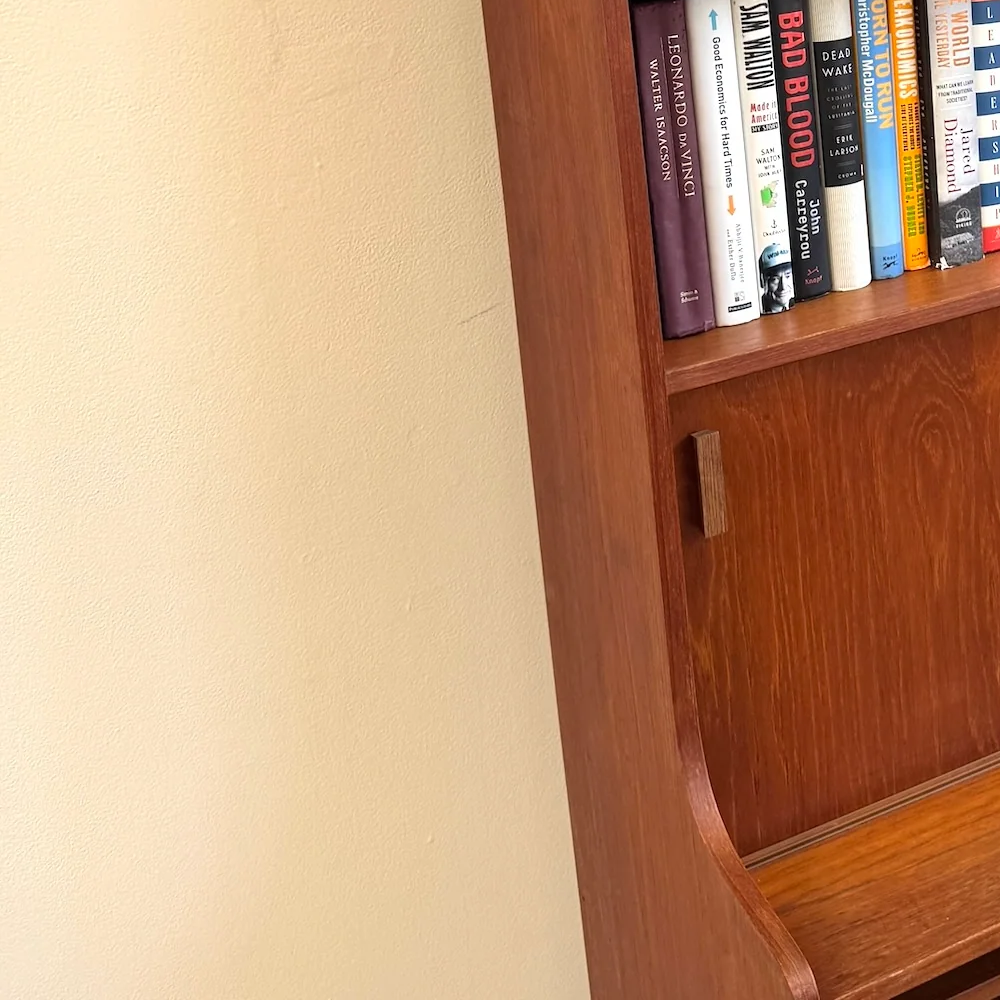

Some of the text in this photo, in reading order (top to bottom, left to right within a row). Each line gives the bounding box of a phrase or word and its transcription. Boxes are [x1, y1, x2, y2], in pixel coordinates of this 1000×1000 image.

[739, 2, 775, 91] SAM WALTON
[822, 47, 851, 62] DEAD
[935, 12, 951, 68] YESTERDAY
[951, 10, 970, 67] WORLD
[821, 63, 853, 78] WAKE
[874, 51, 891, 79] TO
[712, 36, 733, 189] Good Economics for Hard Times
[750, 102, 769, 113] Made
[778, 10, 815, 169] BAD BLOOD
[861, 59, 878, 123] McDougall
[876, 82, 894, 129] RUN
[650, 59, 671, 181] WALTER ISAACSON
[667, 34, 696, 197] LEONARDO DA VINCI
[752, 125, 762, 133] MY
[828, 110, 856, 120] LUSITANIA
[756, 154, 781, 165] WALTON
[761, 147, 775, 156] SAM
[829, 144, 859, 157] LARSON
[835, 134, 854, 144] ERIK
[944, 118, 961, 194] Diamond
[960, 128, 975, 175] Jared
[794, 179, 811, 260] Carreyrou
[809, 199, 823, 236] John
